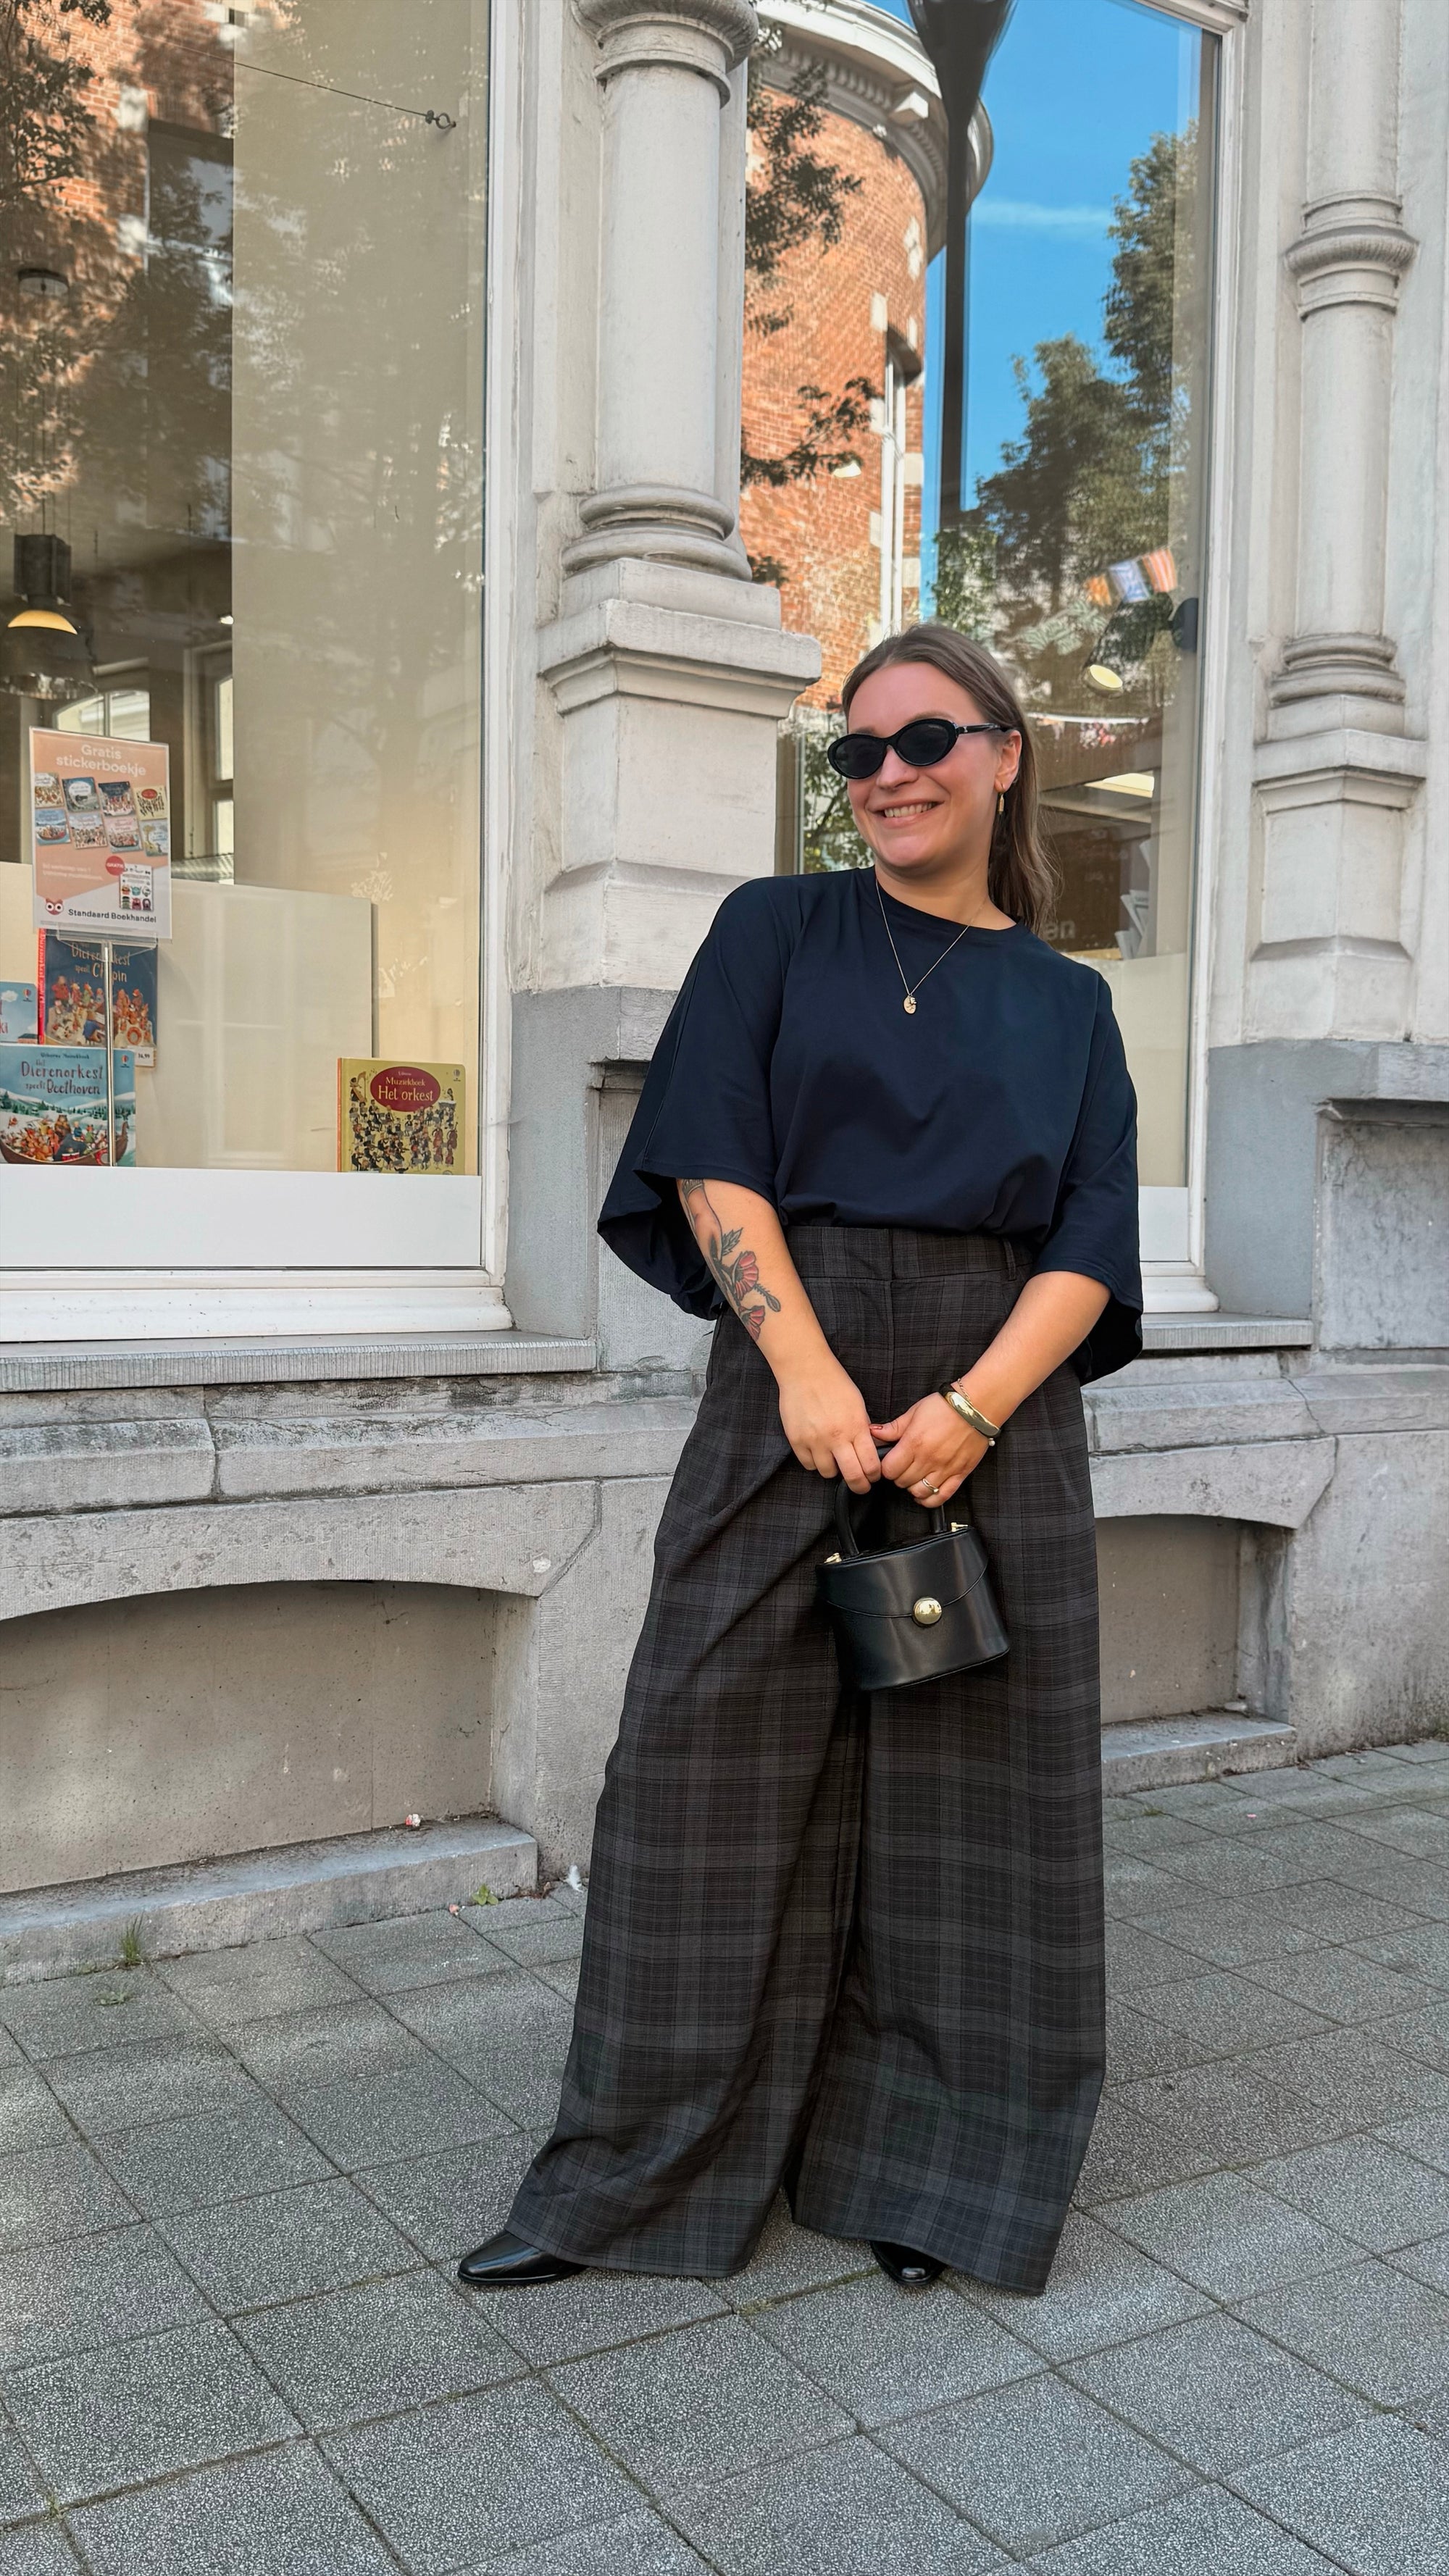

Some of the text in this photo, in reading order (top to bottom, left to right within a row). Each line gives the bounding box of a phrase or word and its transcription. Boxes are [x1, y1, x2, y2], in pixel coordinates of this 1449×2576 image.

[81, 744, 122, 760] Gratis
[56, 755, 146, 777] stickerboekje
[68, 908, 156, 923] Standaard Boekhandel
[22, 1061, 103, 1079] Dierenorkest
[47, 1079, 100, 1095] Beethoven
[385, 1076, 426, 1087] Muziekboek
[378, 1085, 433, 1101] Het orkest
